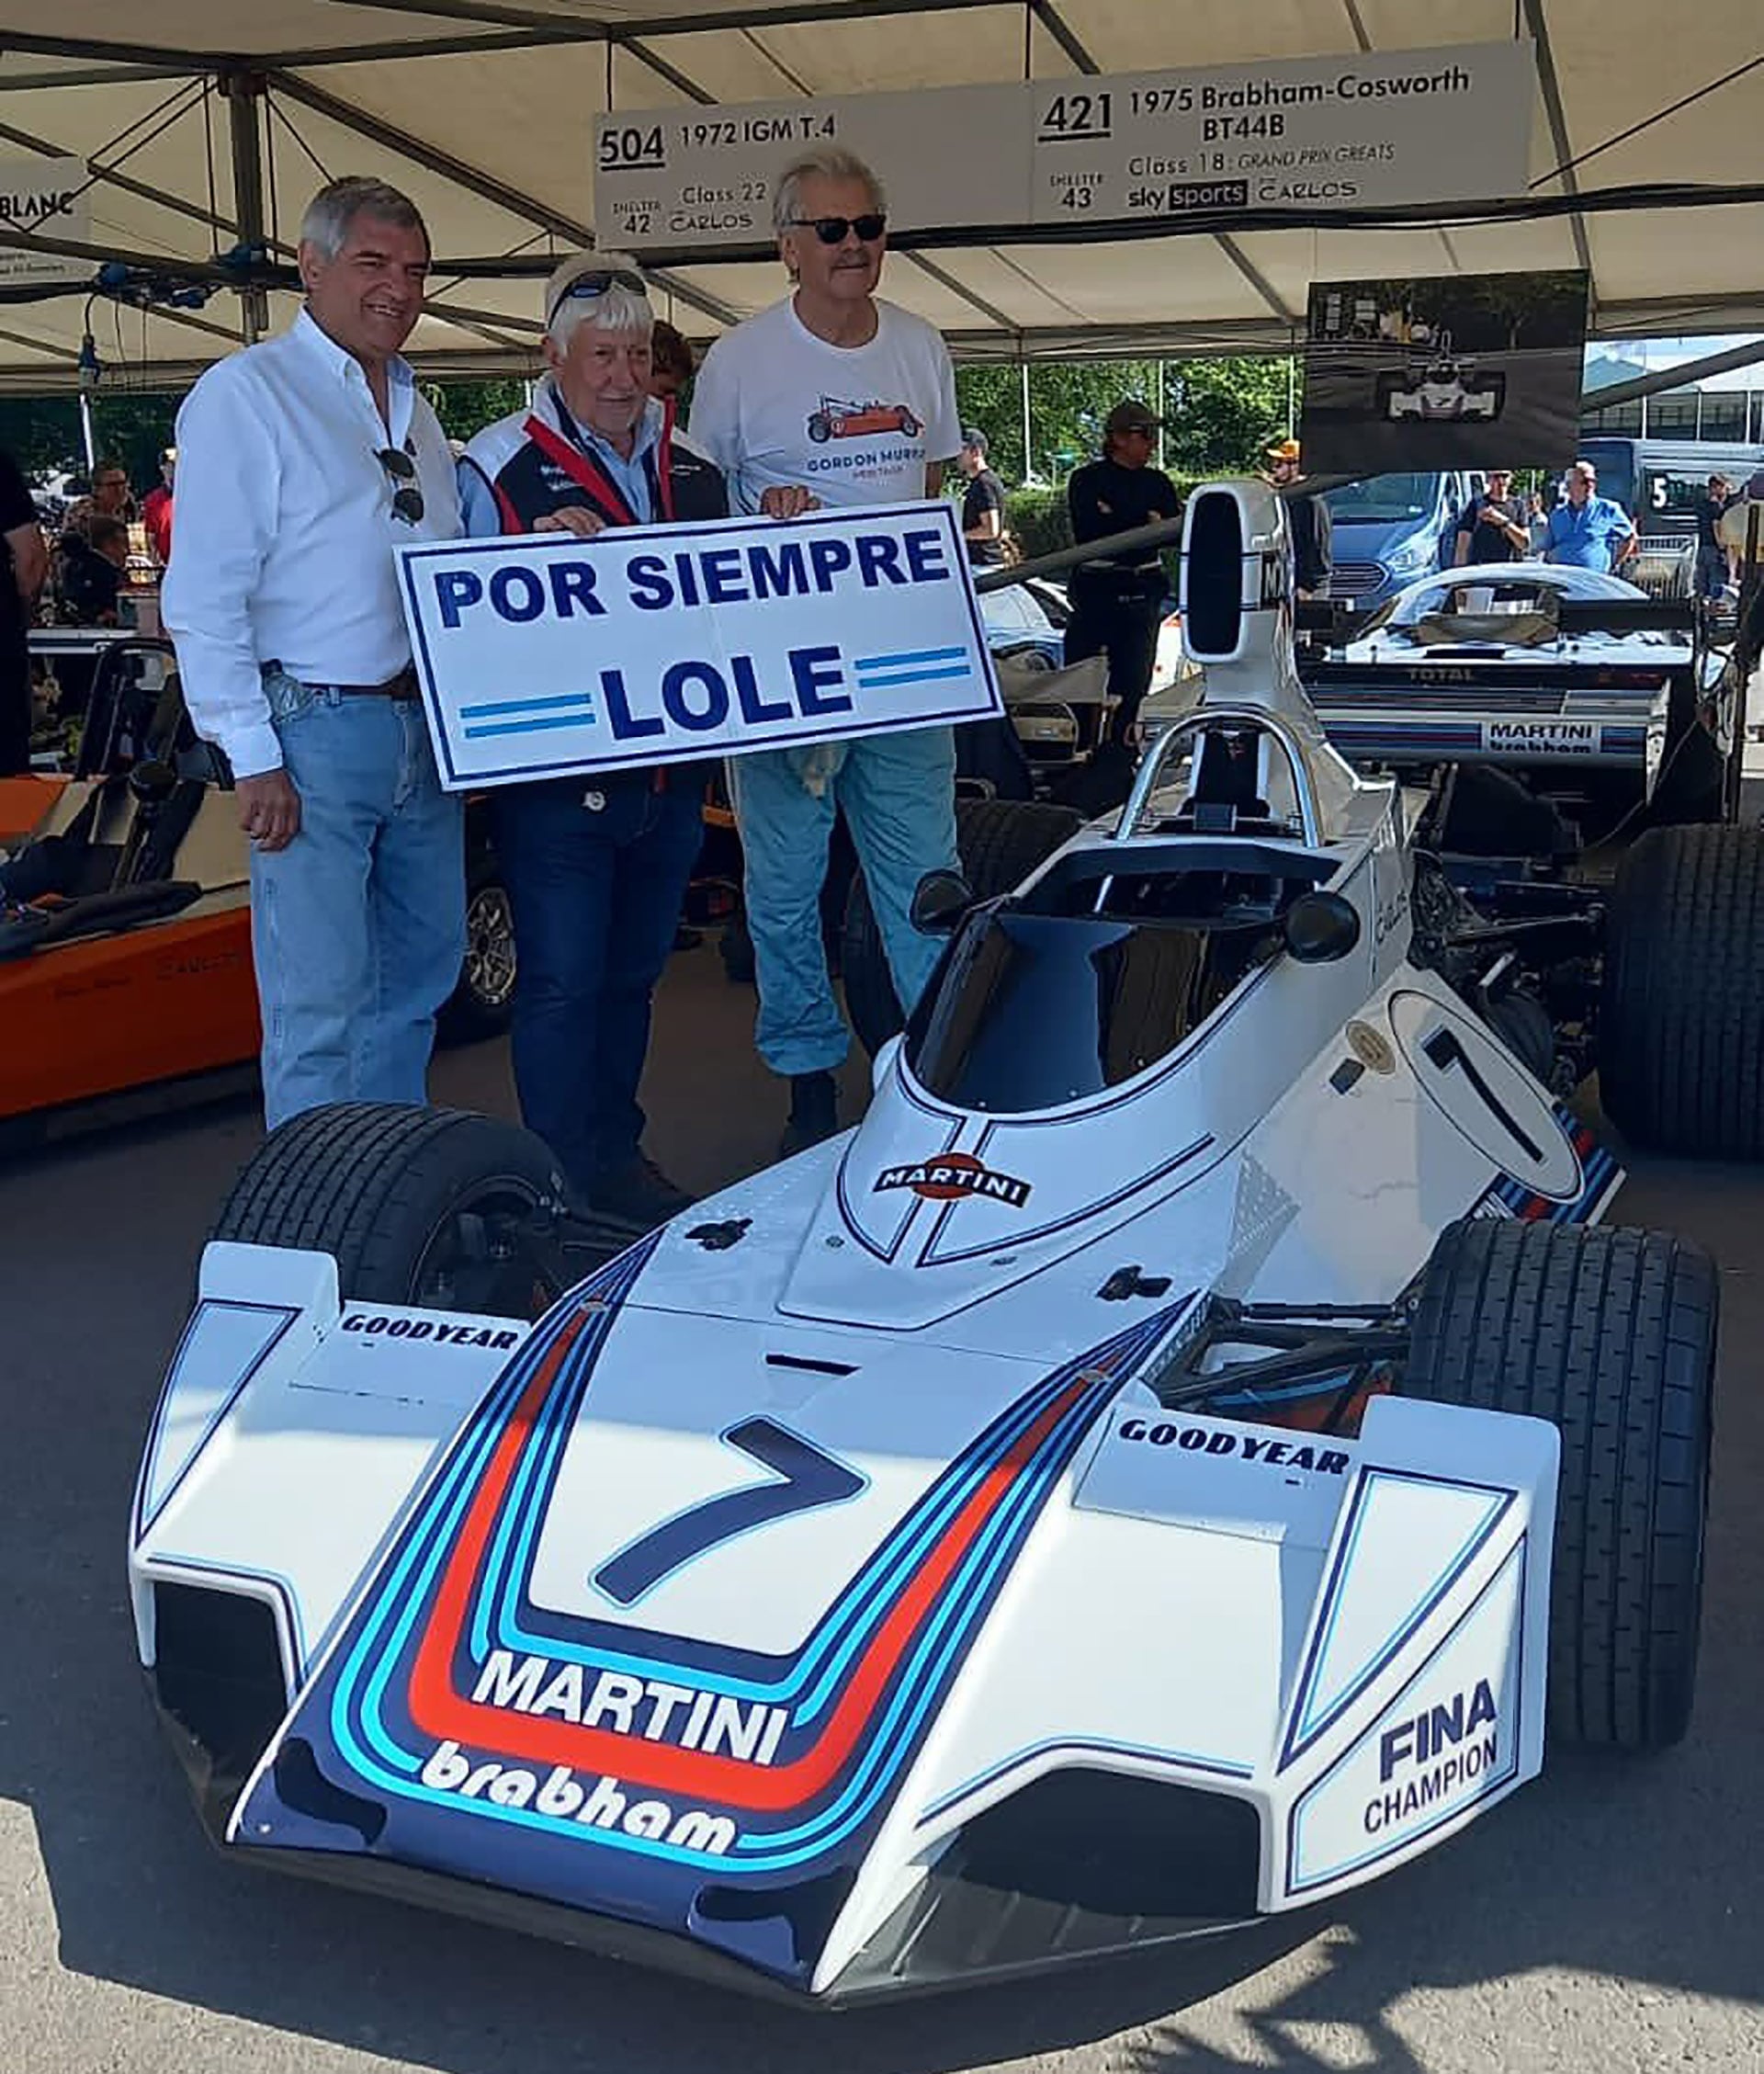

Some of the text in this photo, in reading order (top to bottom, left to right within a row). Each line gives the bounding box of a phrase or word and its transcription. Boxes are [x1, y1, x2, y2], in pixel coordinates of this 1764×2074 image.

[1131, 65, 1470, 115] 1975 Brabham-Cosworth
[1043, 94, 1111, 131] 421
[1203, 113, 1284, 142] BT44B
[600, 126, 665, 164] 504
[681, 115, 836, 147] 1972 IGM T.4
[1128, 157, 1188, 176] Class
[1238, 151, 1295, 169] GRAND
[682, 182, 766, 205] Class 22
[1061, 187, 1092, 209] 43
[1128, 187, 1165, 210] sky
[1172, 184, 1244, 208] sports
[625, 214, 650, 233] 42
[808, 453, 876, 472] GORDON
[1652, 476, 1668, 508] 5
[435, 529, 951, 629] POR SIEMPRE
[600, 645, 854, 740] LOLE
[1490, 722, 1593, 739] MARTINI
[1422, 1026, 1543, 1163] 7
[881, 1167, 1023, 1201] MARTINI
[342, 1314, 519, 1350] GOODYEAR
[1119, 1419, 1351, 1475] GOODYEAR
[593, 1416, 867, 1606] 7
[471, 1649, 788, 1765] MARTINI
[1380, 1678, 1497, 1784] FINA
[421, 1740, 738, 1854] brabham
[1363, 1731, 1498, 1834] CHAMPION
